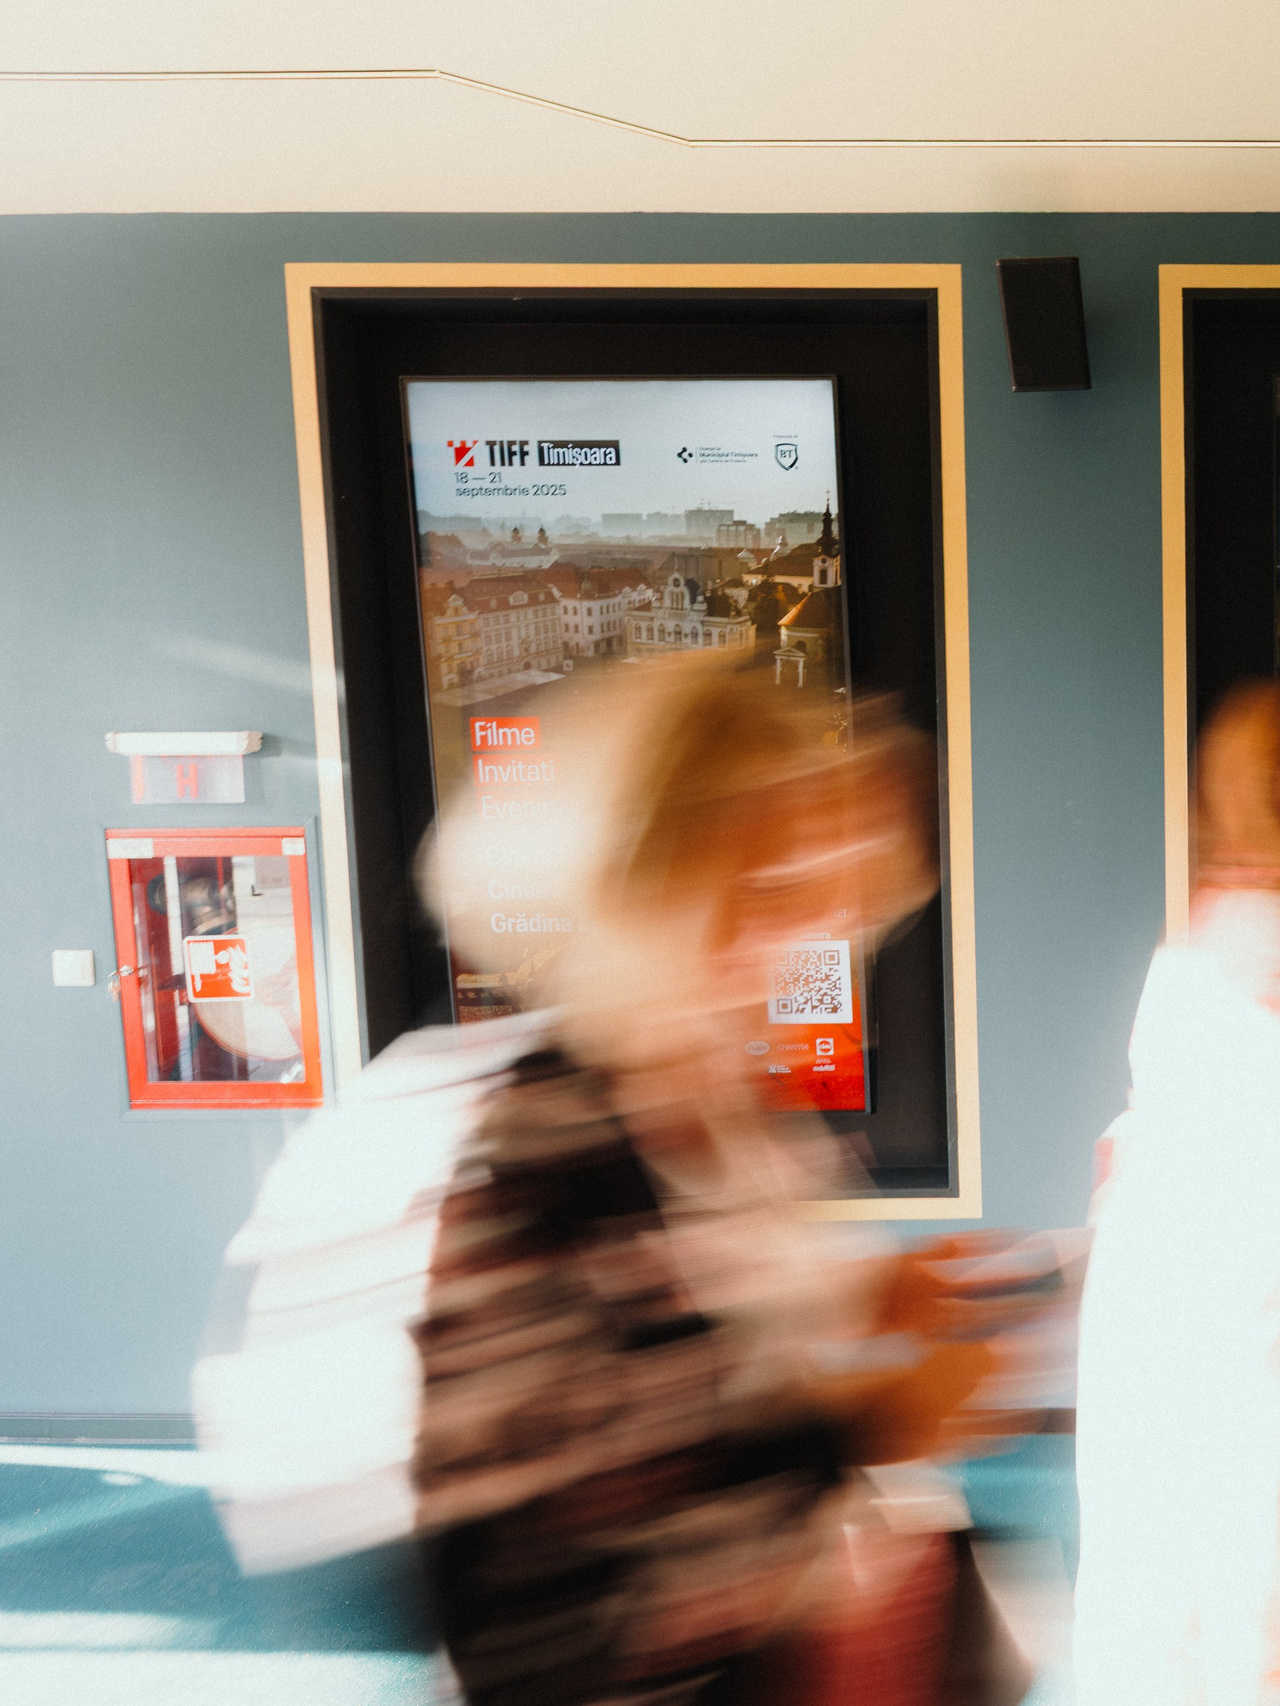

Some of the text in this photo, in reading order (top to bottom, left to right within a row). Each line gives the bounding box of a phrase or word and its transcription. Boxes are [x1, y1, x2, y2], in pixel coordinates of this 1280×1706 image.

[485, 440, 616, 467] TIFF Timișoara
[780, 450, 792, 458] BT
[454, 472, 502, 483] 18 21
[455, 484, 567, 499] septembrie 2025
[475, 721, 535, 746] Filme
[478, 759, 555, 785] Invitați
[491, 912, 572, 933] Grădina
